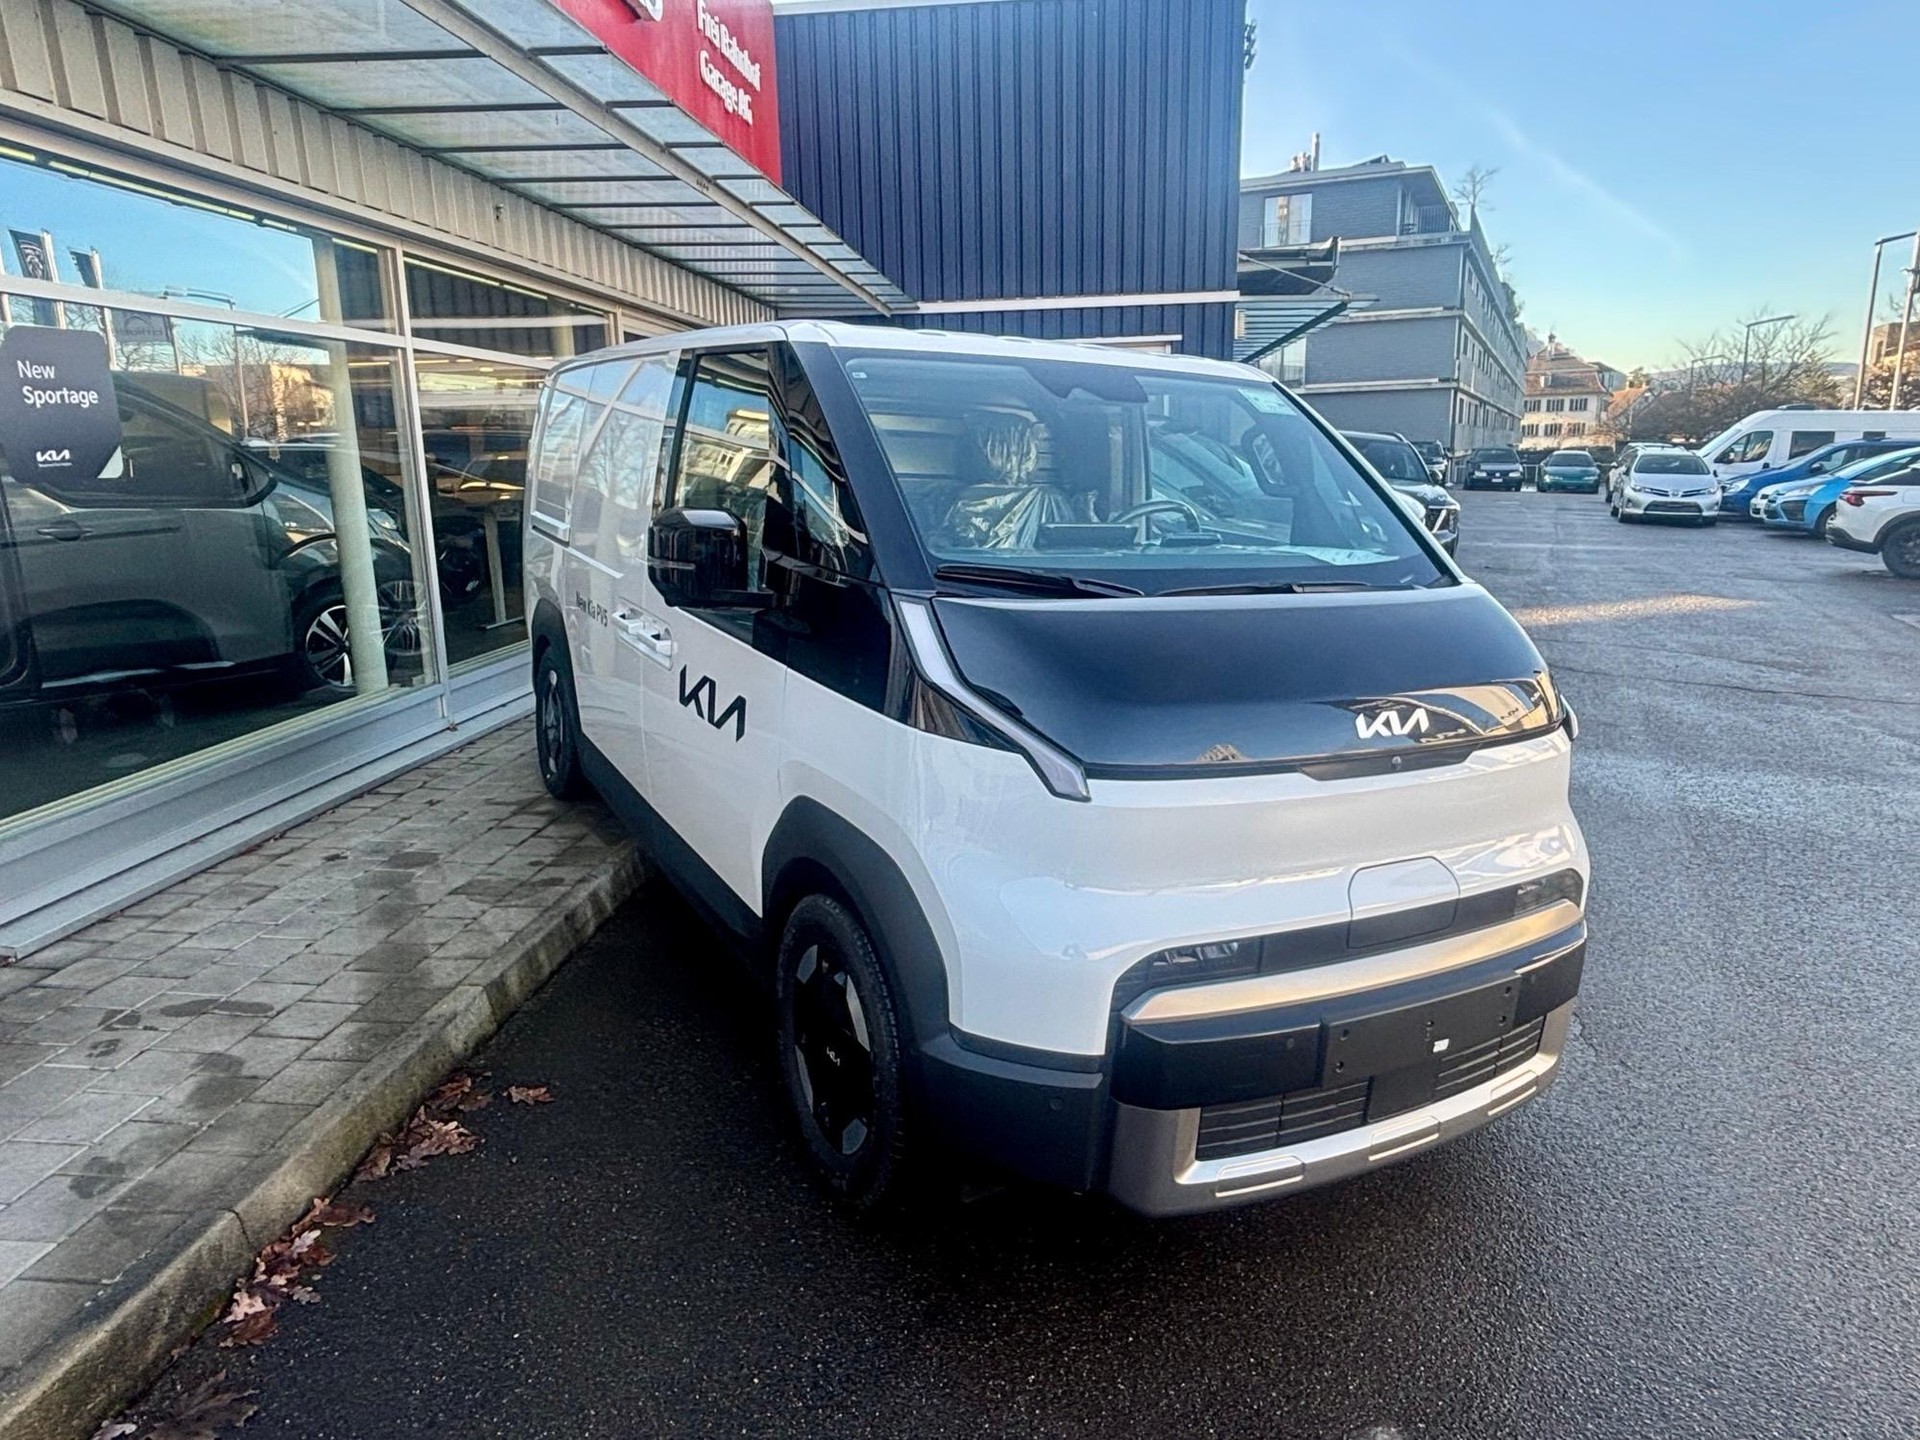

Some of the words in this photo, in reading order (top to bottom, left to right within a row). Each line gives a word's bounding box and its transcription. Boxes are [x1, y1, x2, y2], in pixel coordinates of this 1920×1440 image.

[700, 49, 738, 114] Garage
[17, 360, 55, 379] New
[22, 385, 99, 409] Sportage
[36, 449, 70, 462] KIA
[679, 664, 747, 743] KIA
[1355, 707, 1430, 740] KIA
